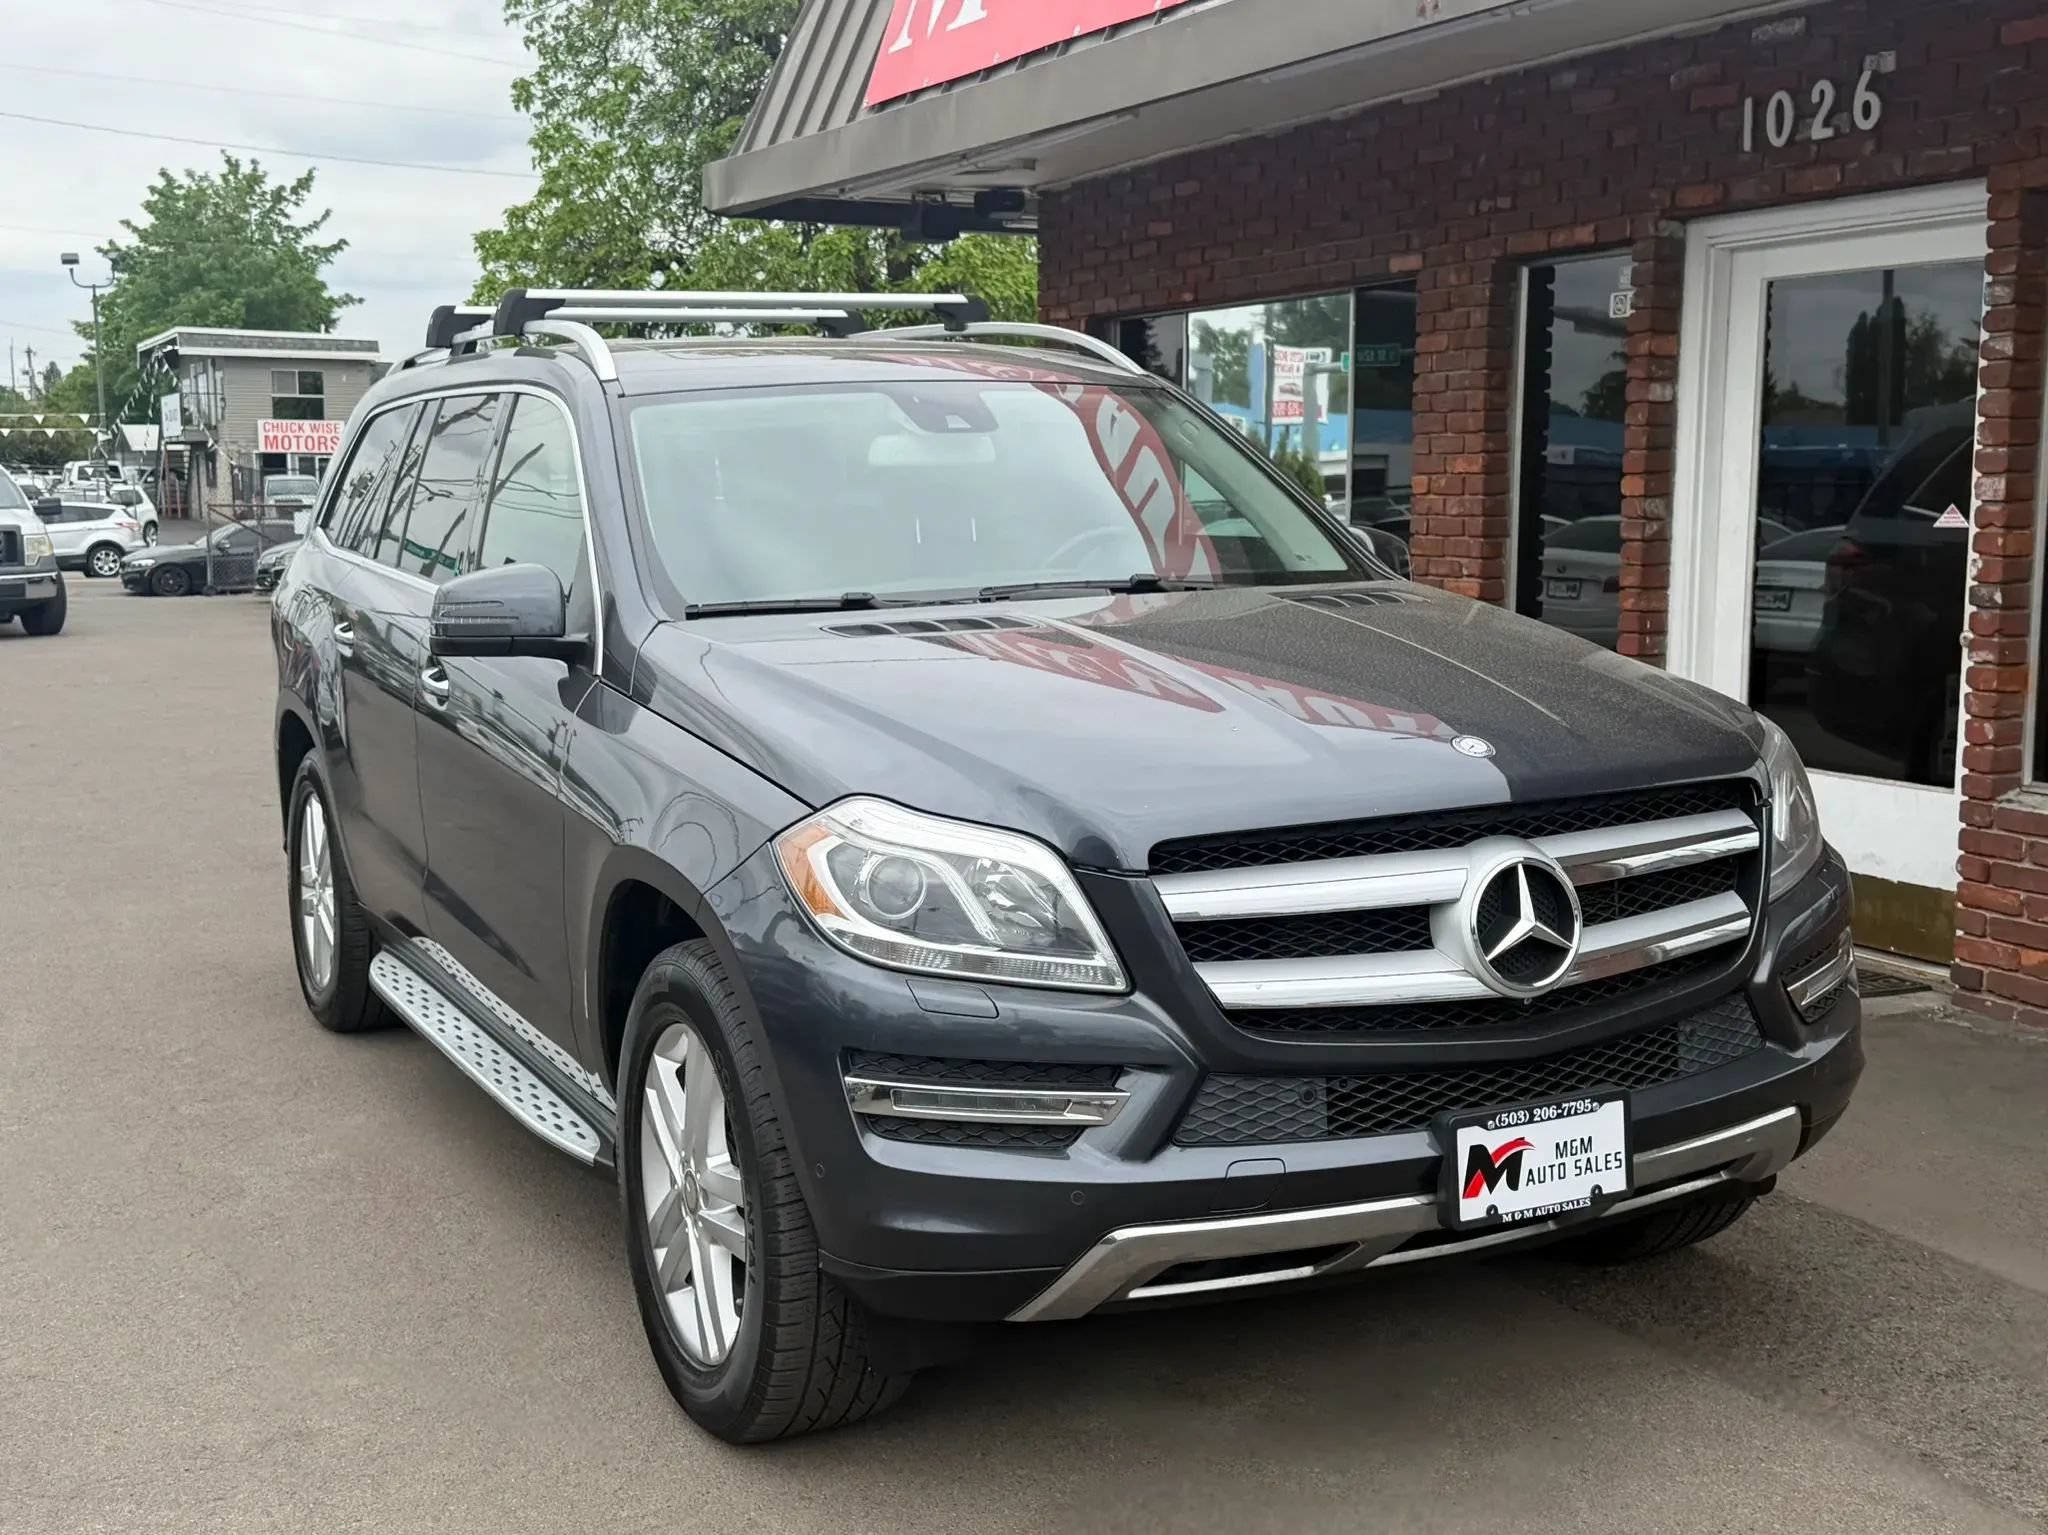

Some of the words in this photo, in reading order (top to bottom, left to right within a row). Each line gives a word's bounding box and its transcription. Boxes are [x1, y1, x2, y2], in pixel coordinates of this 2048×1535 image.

[1743, 70, 1881, 152] 1026
[264, 421, 305, 433] CHUCK
[309, 423, 341, 434] WISE
[264, 435, 340, 451] MOTORS
[1495, 1110, 1529, 1127] (503)
[1533, 1099, 1592, 1121] 206-7795
[1555, 1136, 1592, 1160] M&M
[1526, 1161, 1566, 1187] AUTO
[1574, 1151, 1623, 1177] SALES
[1502, 1213, 1512, 1223] M
[1523, 1208, 1534, 1219] M
[1535, 1203, 1560, 1217] AUTO
[1562, 1198, 1591, 1212] SALES
